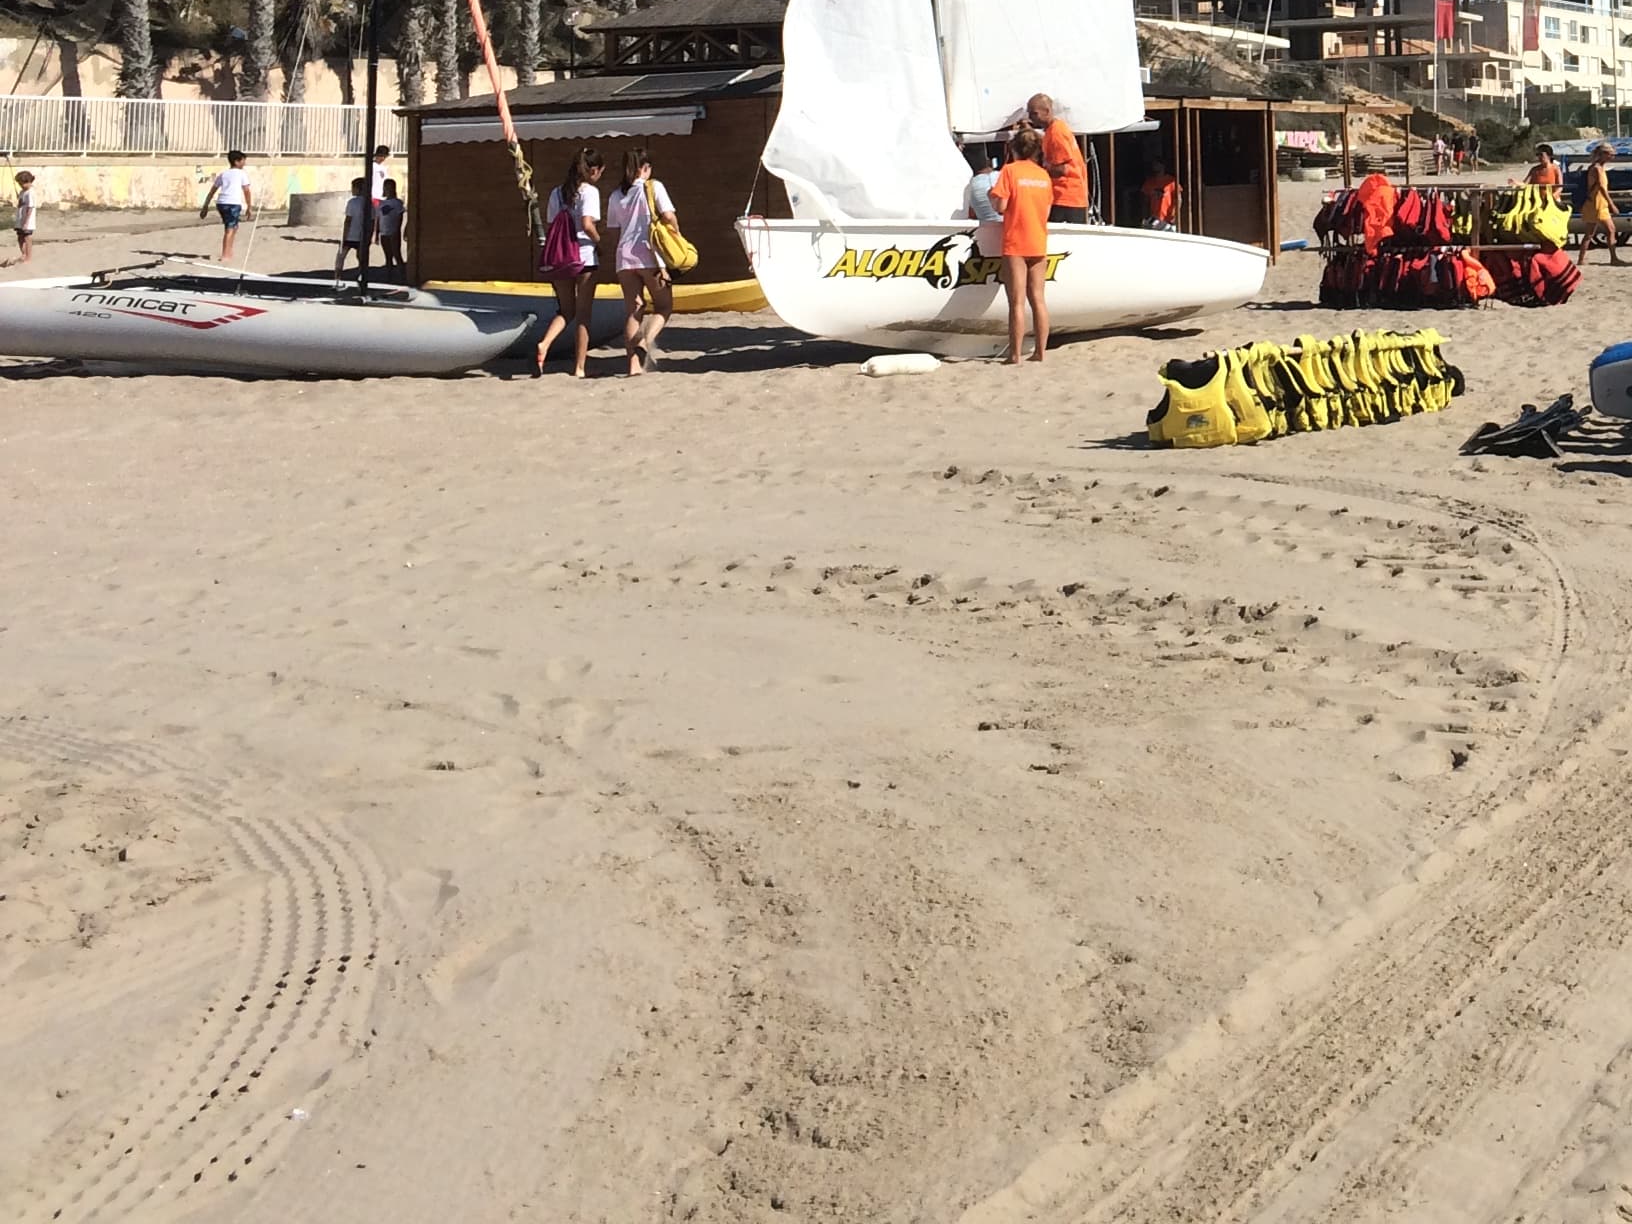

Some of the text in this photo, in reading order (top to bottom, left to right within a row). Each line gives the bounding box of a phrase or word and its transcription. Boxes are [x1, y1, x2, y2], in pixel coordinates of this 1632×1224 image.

[826, 248, 1070, 284] ALOHA SPT
[68, 310, 112, 319] 420
[71, 293, 196, 315] minicat
